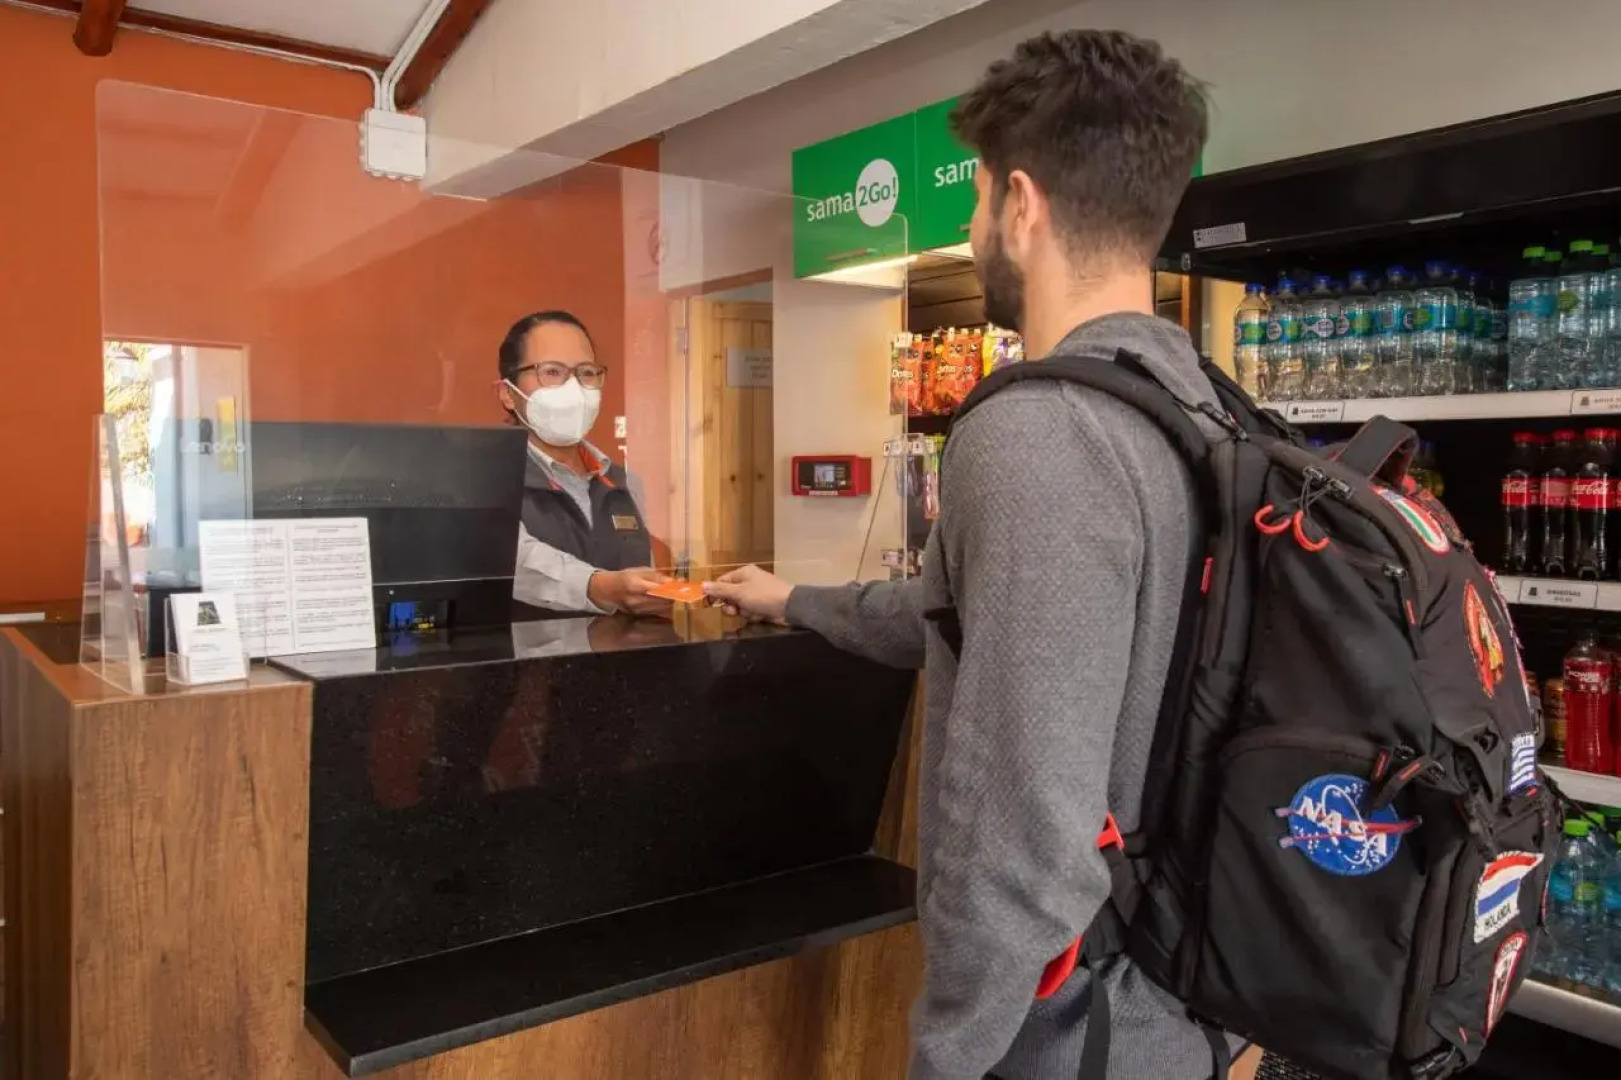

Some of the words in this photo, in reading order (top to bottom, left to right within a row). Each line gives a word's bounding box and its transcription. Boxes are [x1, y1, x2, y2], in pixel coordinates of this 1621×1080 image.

[807, 191, 855, 222] sama
[858, 177, 897, 207] 2Go!
[1297, 795, 1388, 857] NASA
